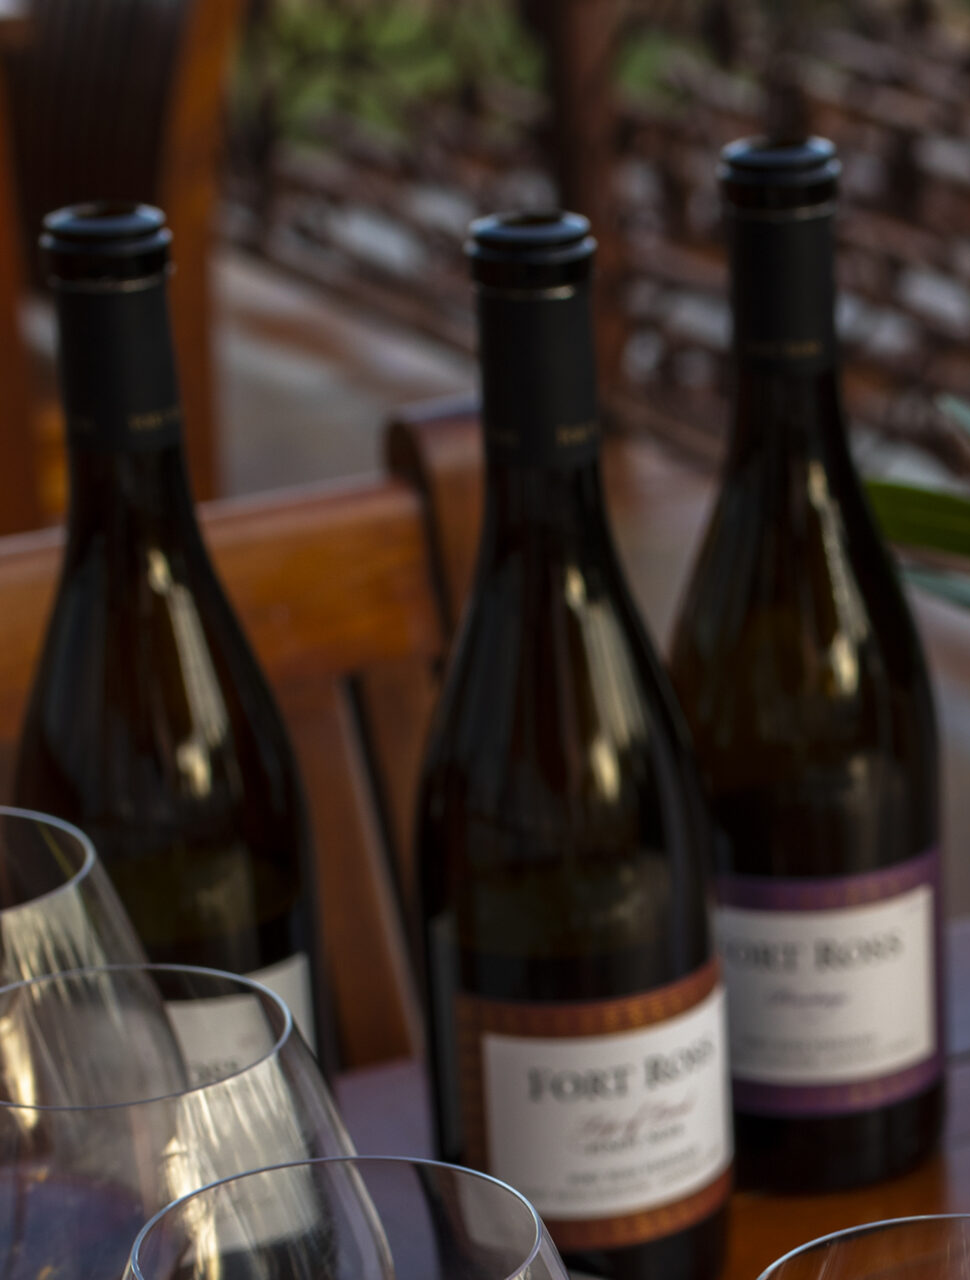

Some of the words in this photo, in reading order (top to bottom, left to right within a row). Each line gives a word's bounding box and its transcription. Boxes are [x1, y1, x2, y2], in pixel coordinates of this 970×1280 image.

[815, 929, 904, 972] ROSS
[526, 1064, 634, 1104] FORT
[644, 1035, 715, 1089] ROSS
